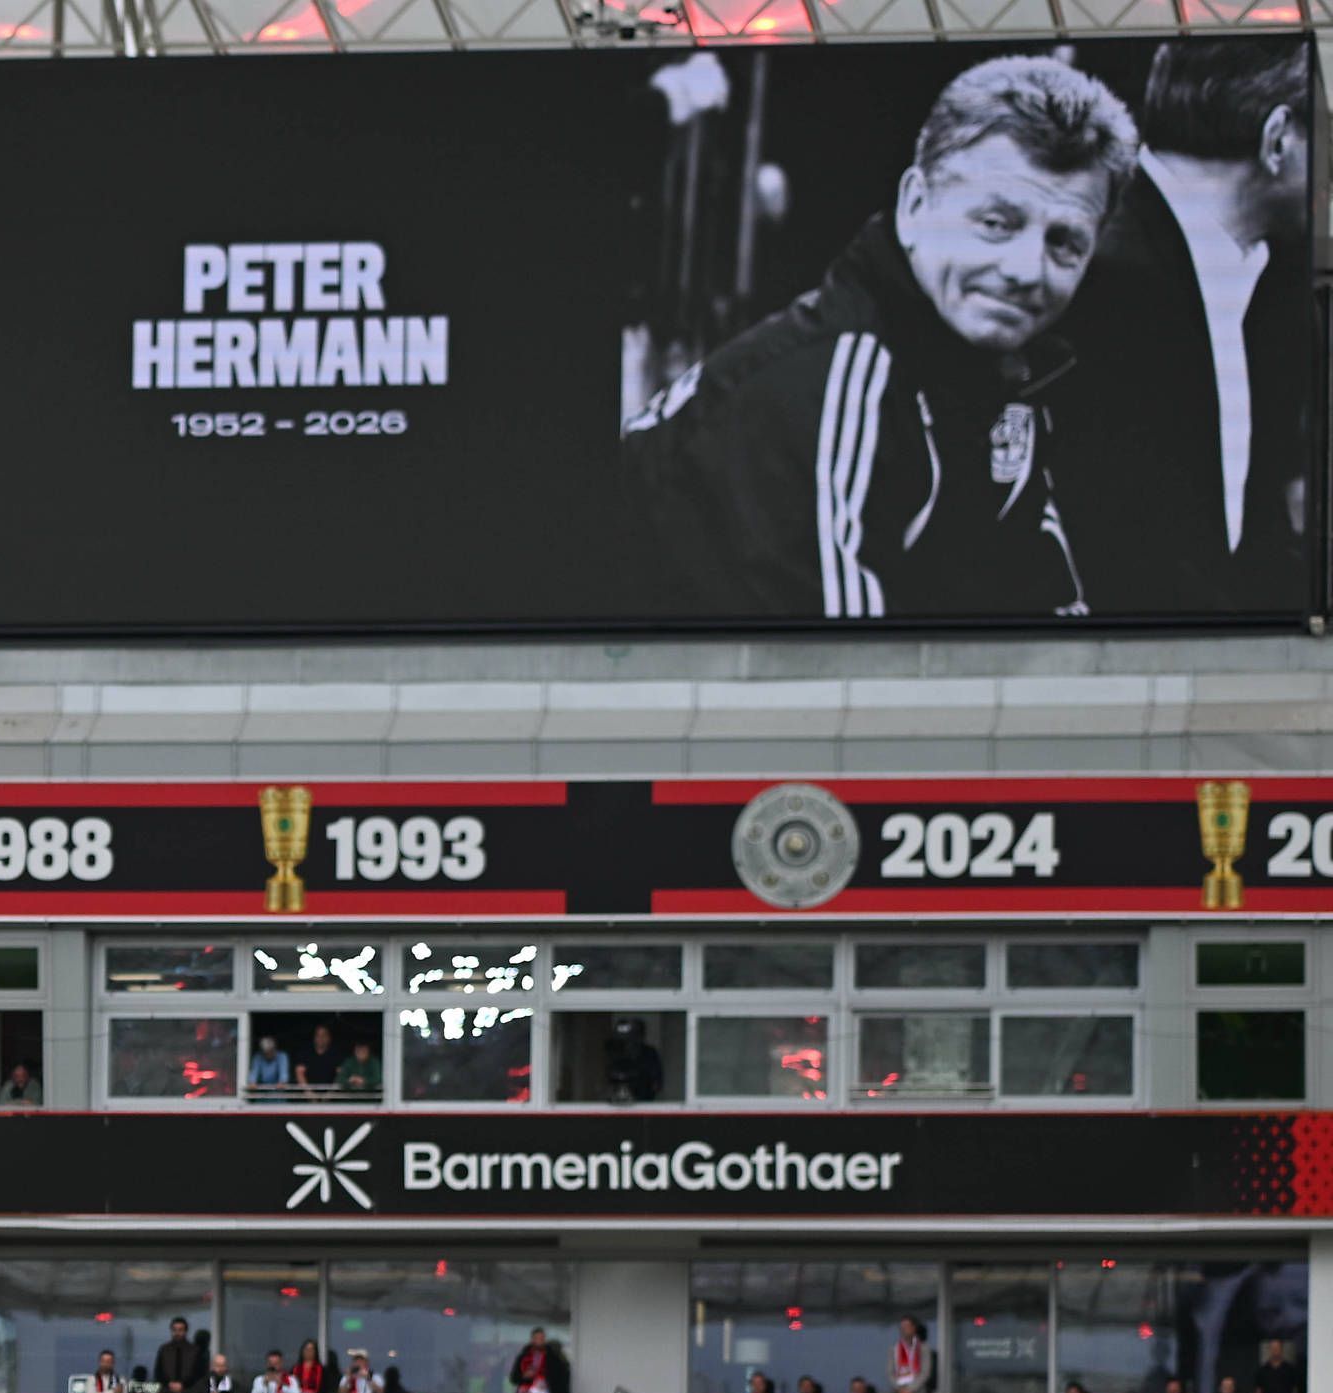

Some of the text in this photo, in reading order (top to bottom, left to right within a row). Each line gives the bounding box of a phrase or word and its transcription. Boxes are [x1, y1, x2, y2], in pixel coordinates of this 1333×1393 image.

[183, 242, 386, 313] PETER
[131, 316, 449, 389] HERMANN
[171, 412, 265, 438] 1952
[304, 411, 408, 436] 2026
[326, 815, 487, 882] 1993
[880, 812, 1060, 879] 2024
[403, 1140, 901, 1191] BarmeniaGothaer
